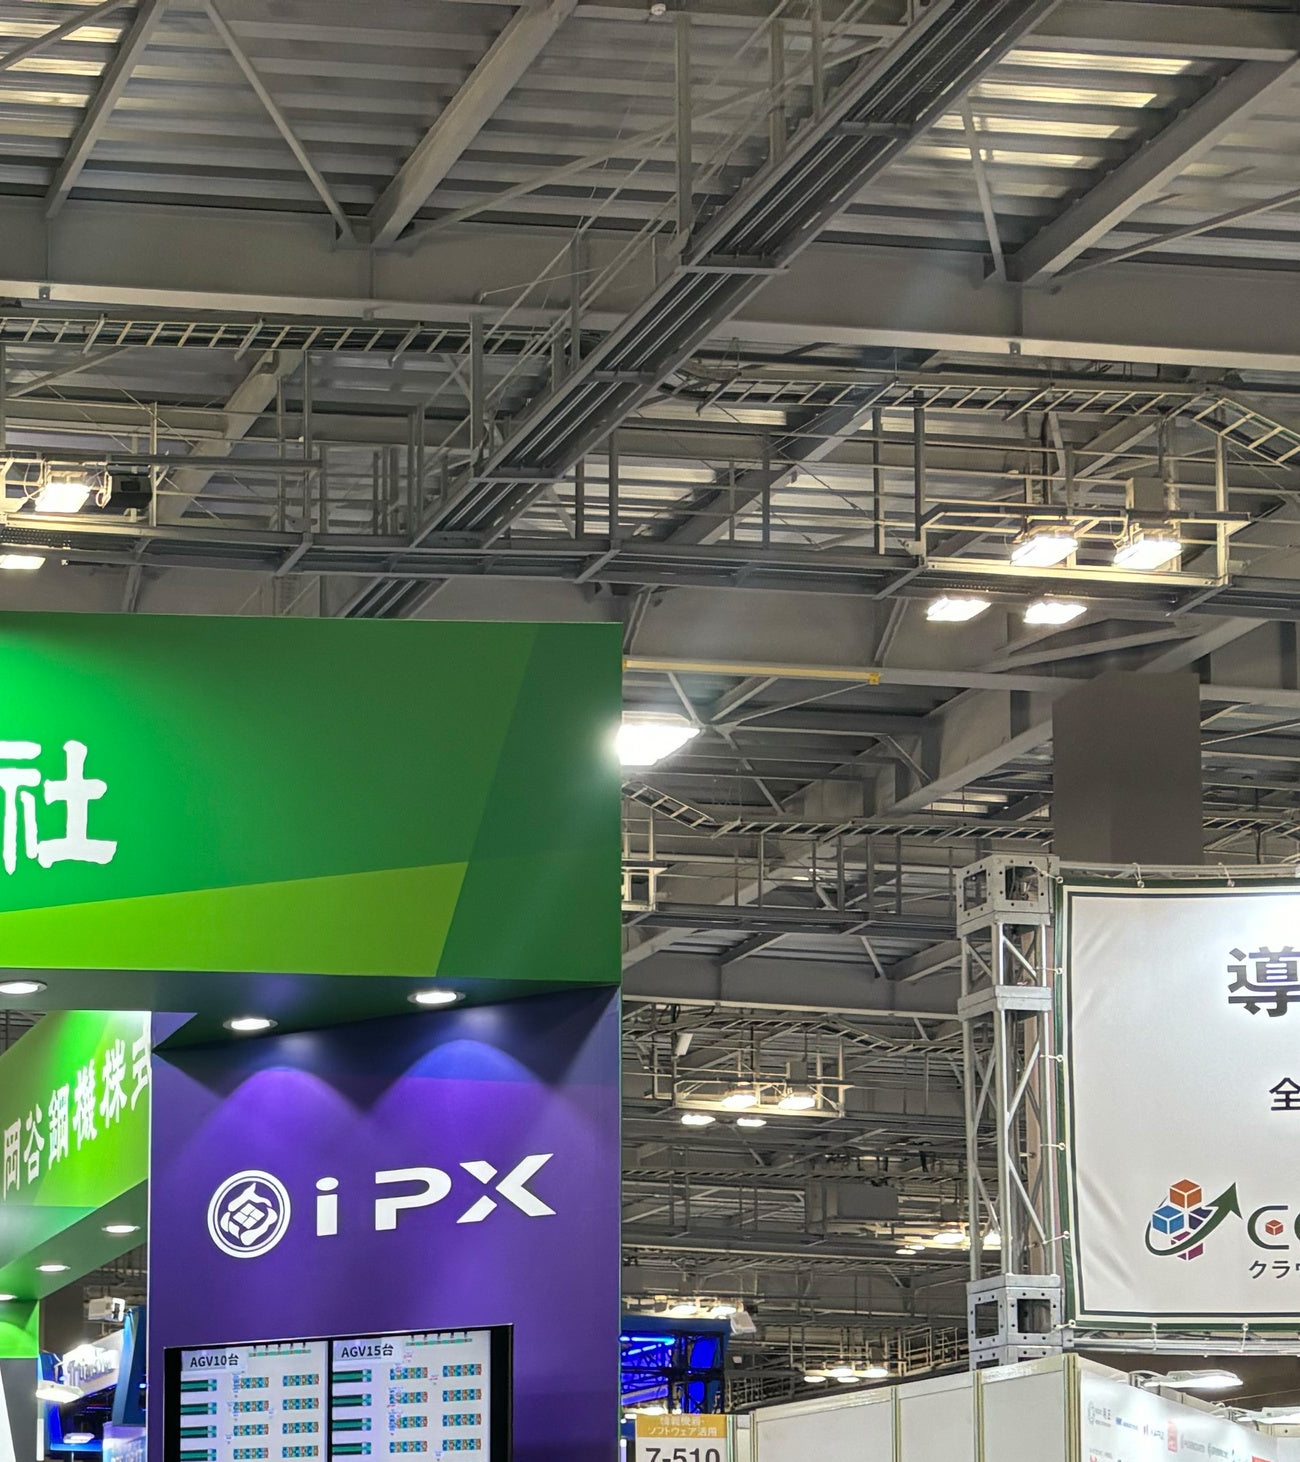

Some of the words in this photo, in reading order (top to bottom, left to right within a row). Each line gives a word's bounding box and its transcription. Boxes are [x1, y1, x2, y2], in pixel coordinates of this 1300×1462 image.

[1249, 1260, 1300, 1279] クラ
[341, 1343, 394, 1358] AGV15台
[190, 1353, 239, 1368] AGV10台
